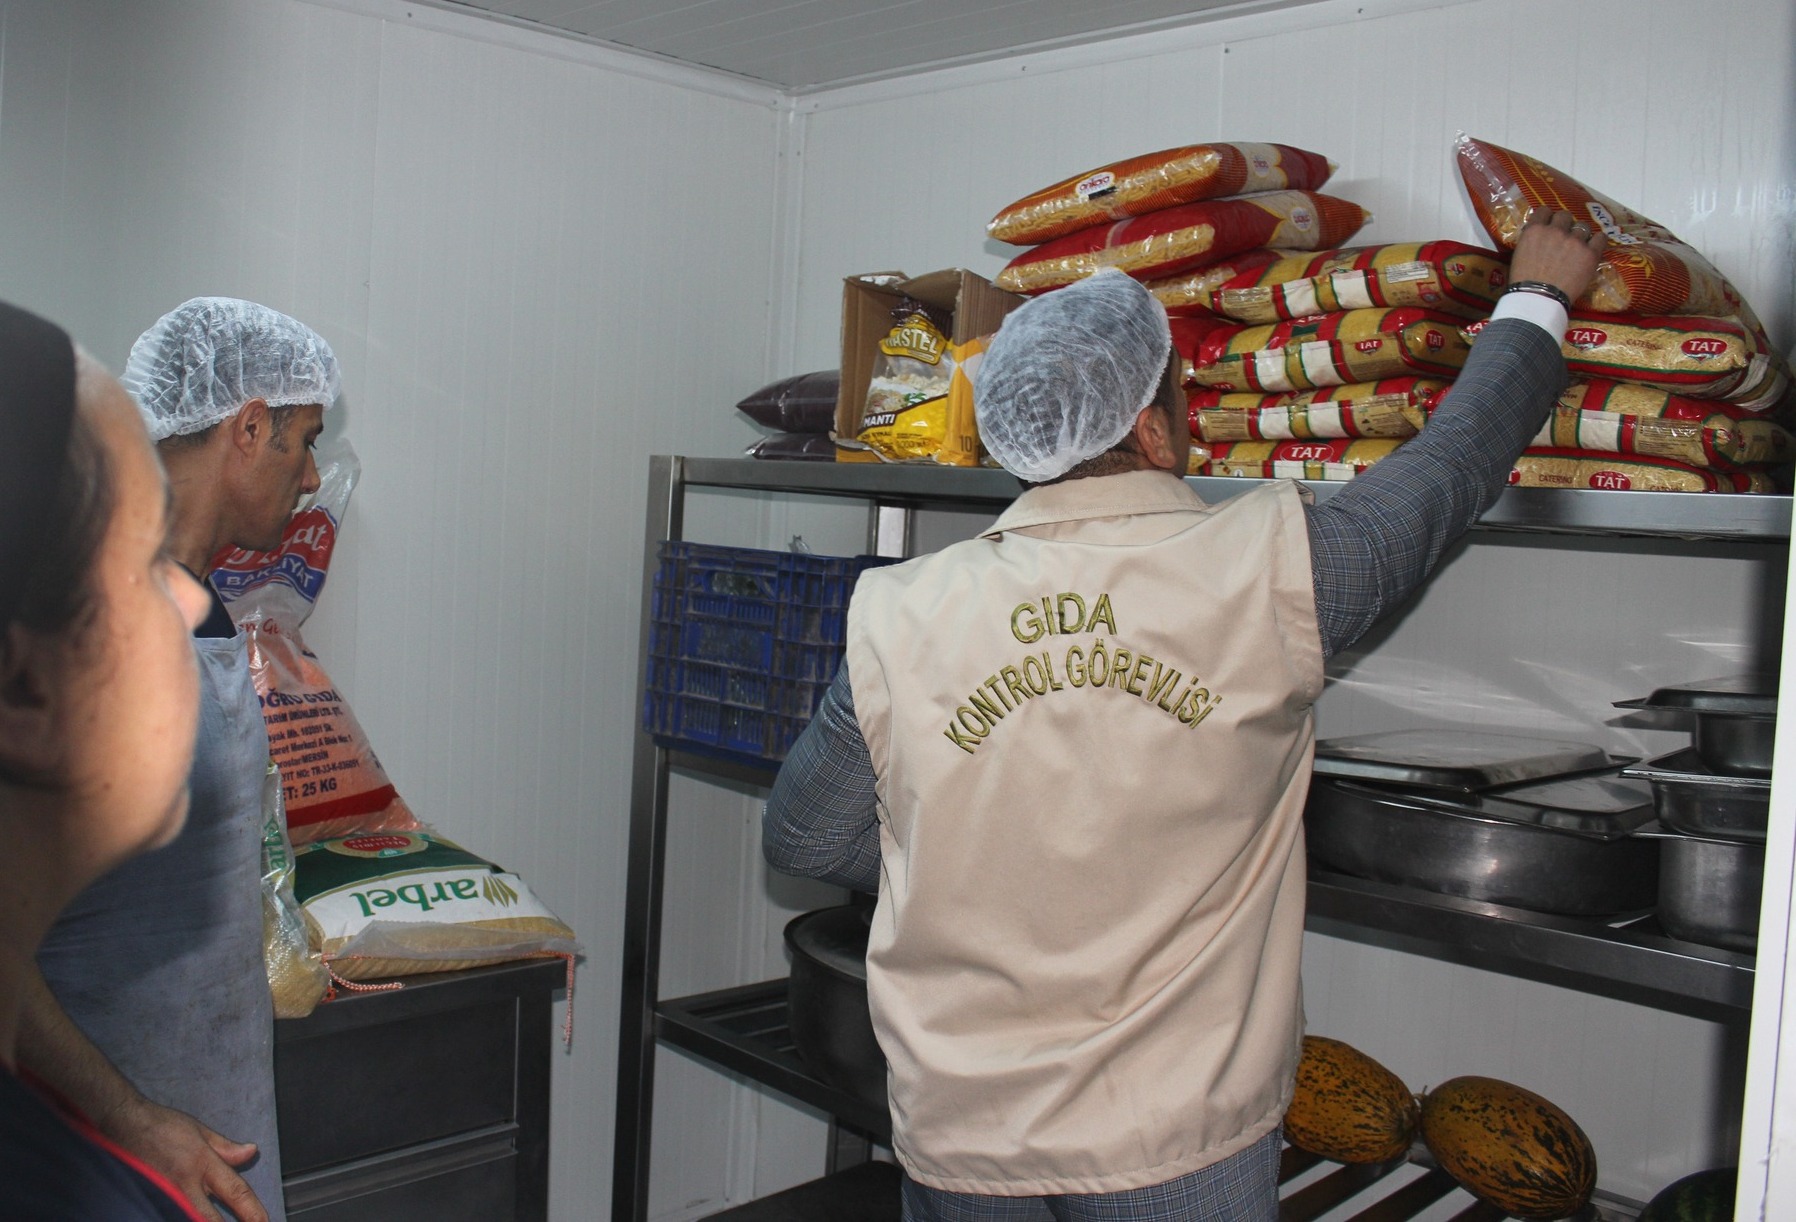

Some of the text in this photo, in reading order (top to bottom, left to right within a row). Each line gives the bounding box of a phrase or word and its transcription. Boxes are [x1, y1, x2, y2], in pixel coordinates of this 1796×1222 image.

[1428, 334, 1442, 347] TAT
[1572, 330, 1602, 343] TAT
[1690, 340, 1721, 352] TAT
[864, 413, 895, 427] MANTI
[960, 435, 972, 452] 10
[1291, 447, 1327, 458] TAT
[1595, 475, 1625, 489] TAT
[1010, 592, 1117, 643] GIDA
[303, 689, 342, 704] GIDA
[943, 638, 1222, 754] KONTROL GÖREVLİSİ
[302, 782, 316, 797] 25
[320, 777, 337, 793] KG
[350, 879, 478, 917] arbel
